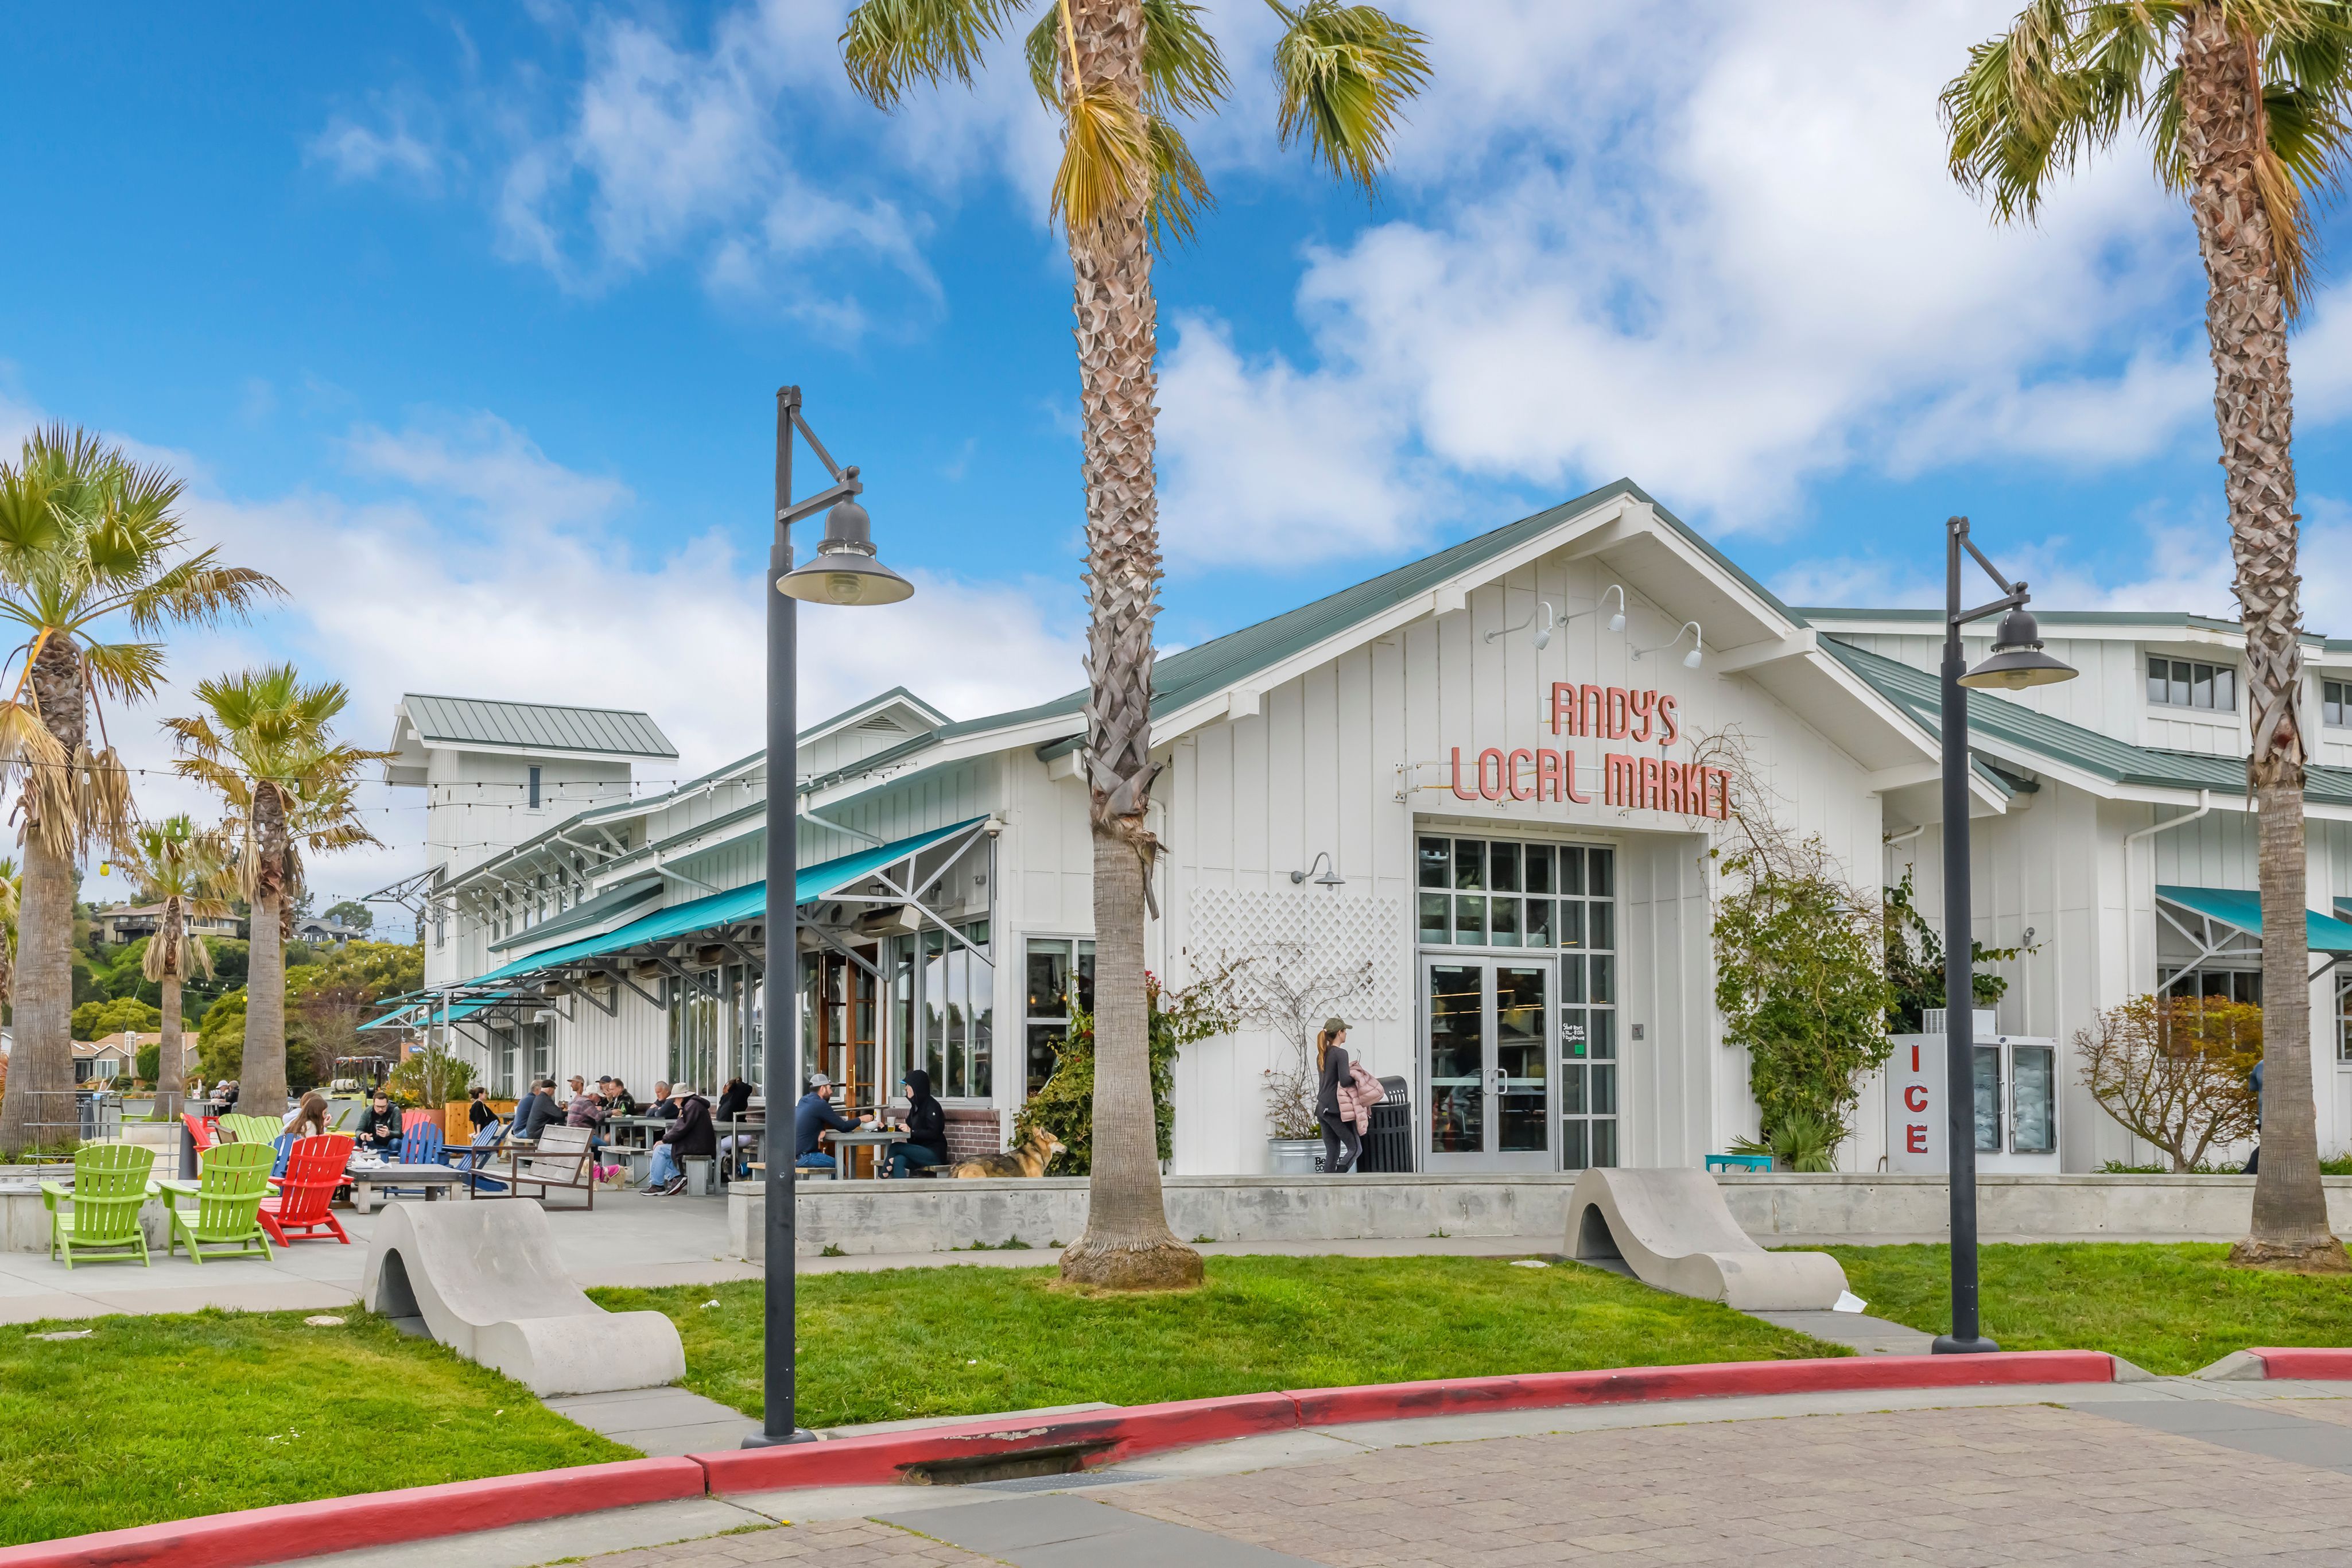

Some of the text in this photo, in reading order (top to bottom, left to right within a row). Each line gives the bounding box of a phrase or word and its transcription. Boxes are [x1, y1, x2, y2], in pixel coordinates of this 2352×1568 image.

[1552, 682, 1679, 746] ANDY'S
[1452, 747, 1733, 821] LOCAL MARKET
[1904, 1041, 1928, 1153] ICE
